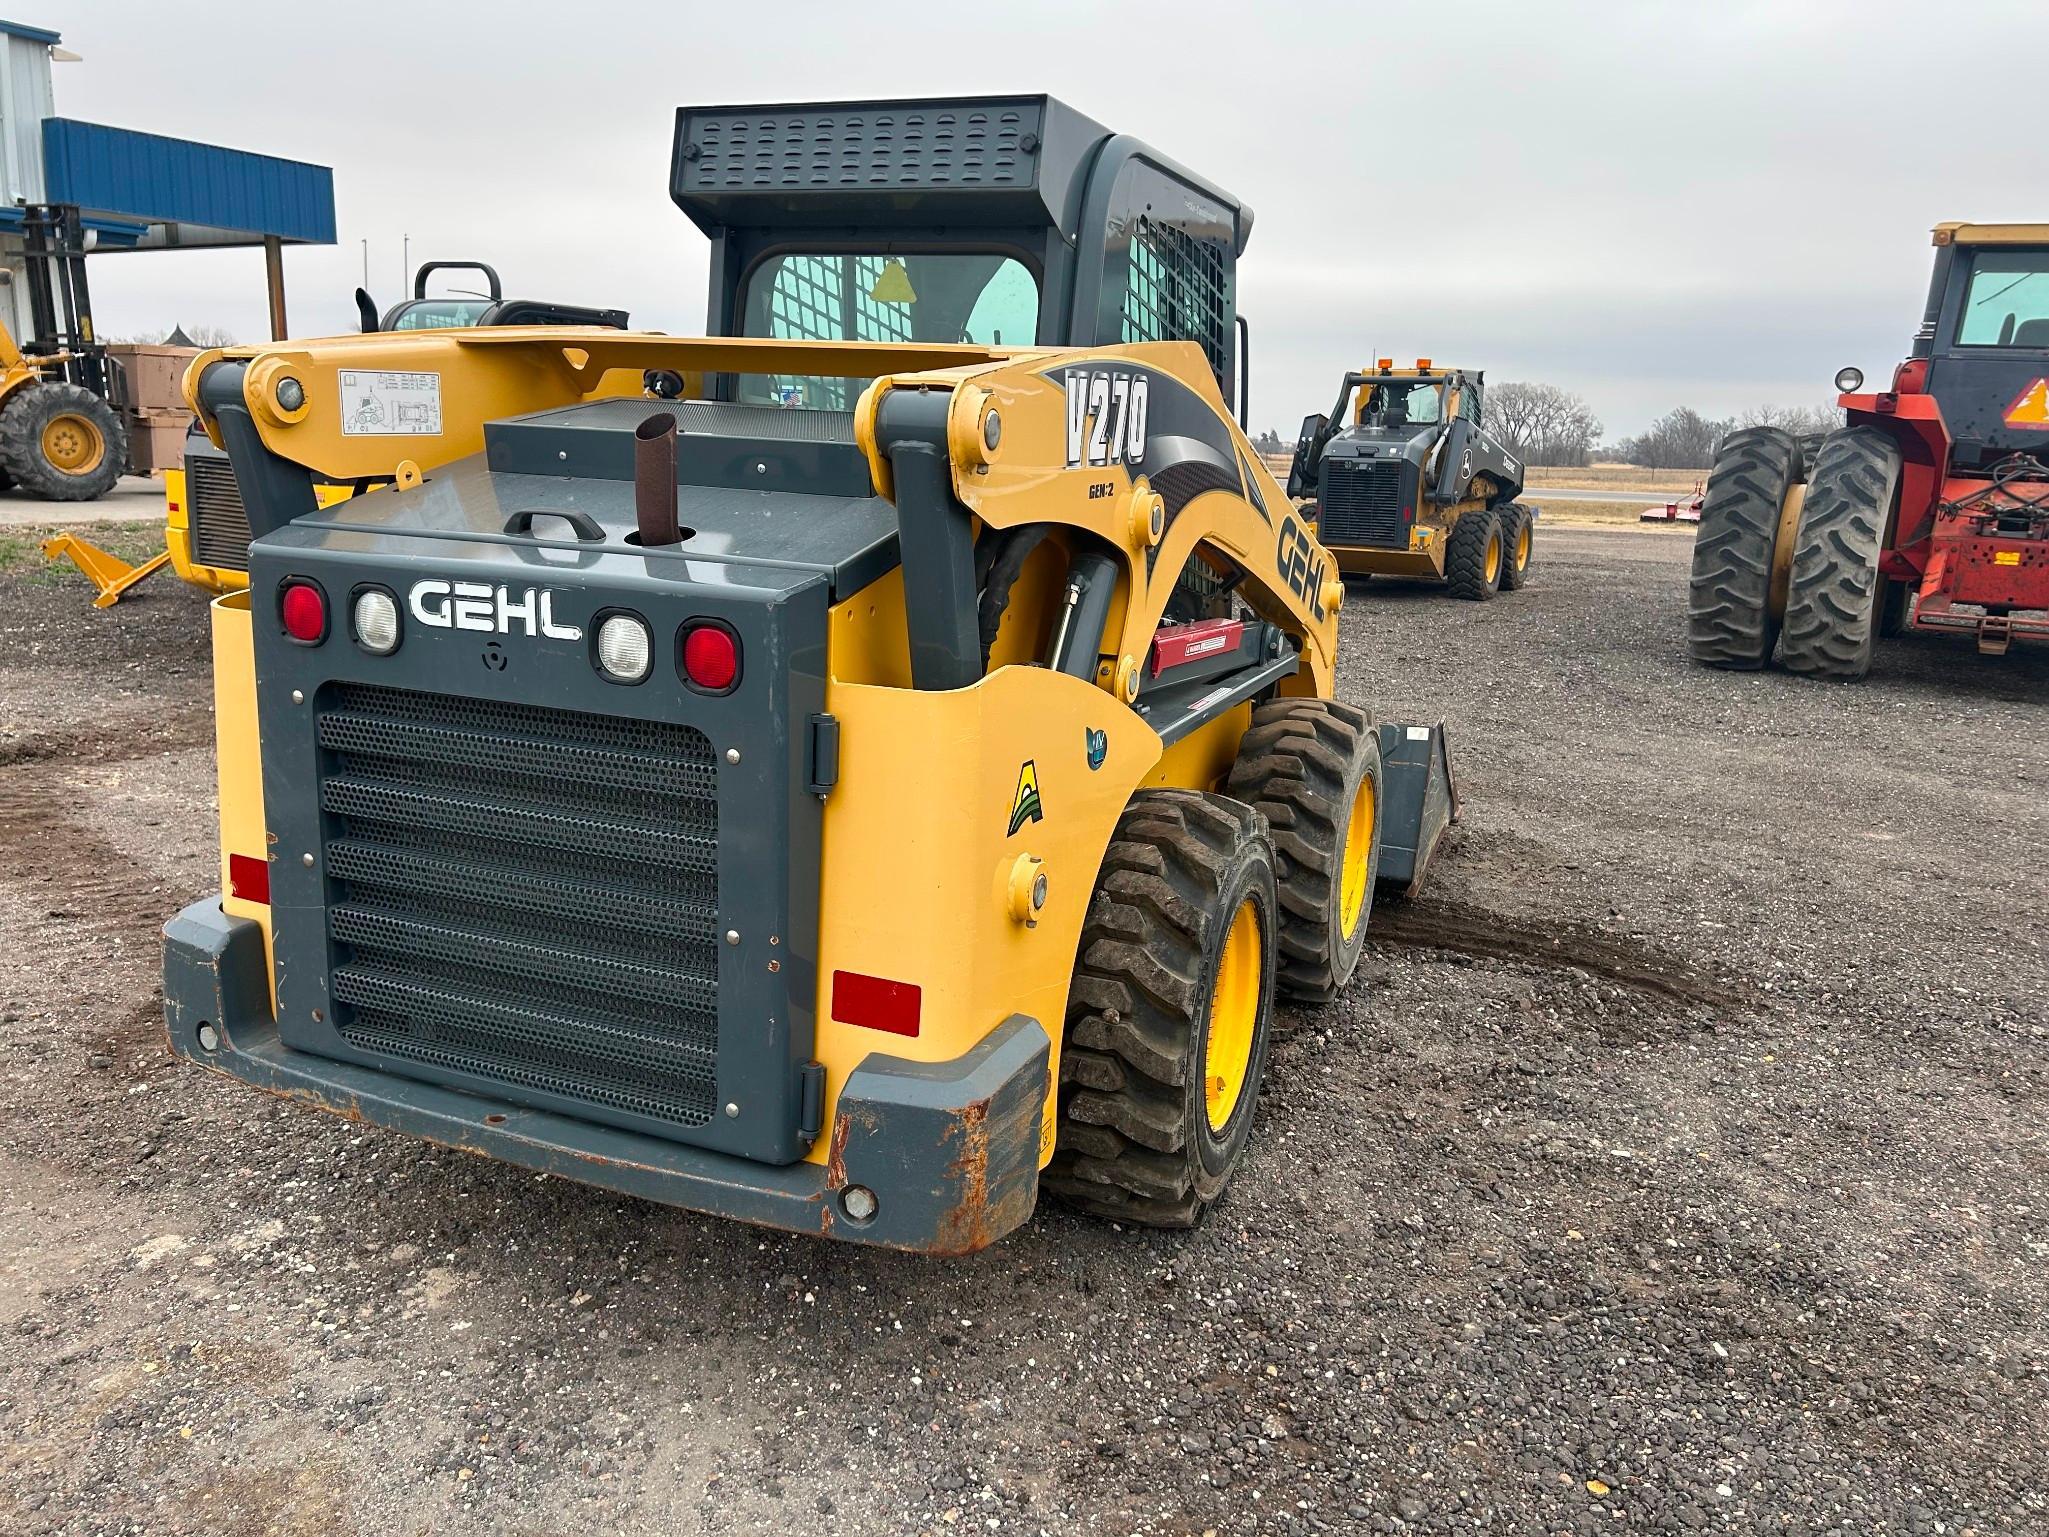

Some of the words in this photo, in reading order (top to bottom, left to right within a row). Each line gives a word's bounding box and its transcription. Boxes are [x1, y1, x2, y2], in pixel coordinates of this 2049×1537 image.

[1065, 368, 1149, 466] V270
[409, 579, 583, 641] GEHL
[1277, 515, 1325, 625] GEHL
